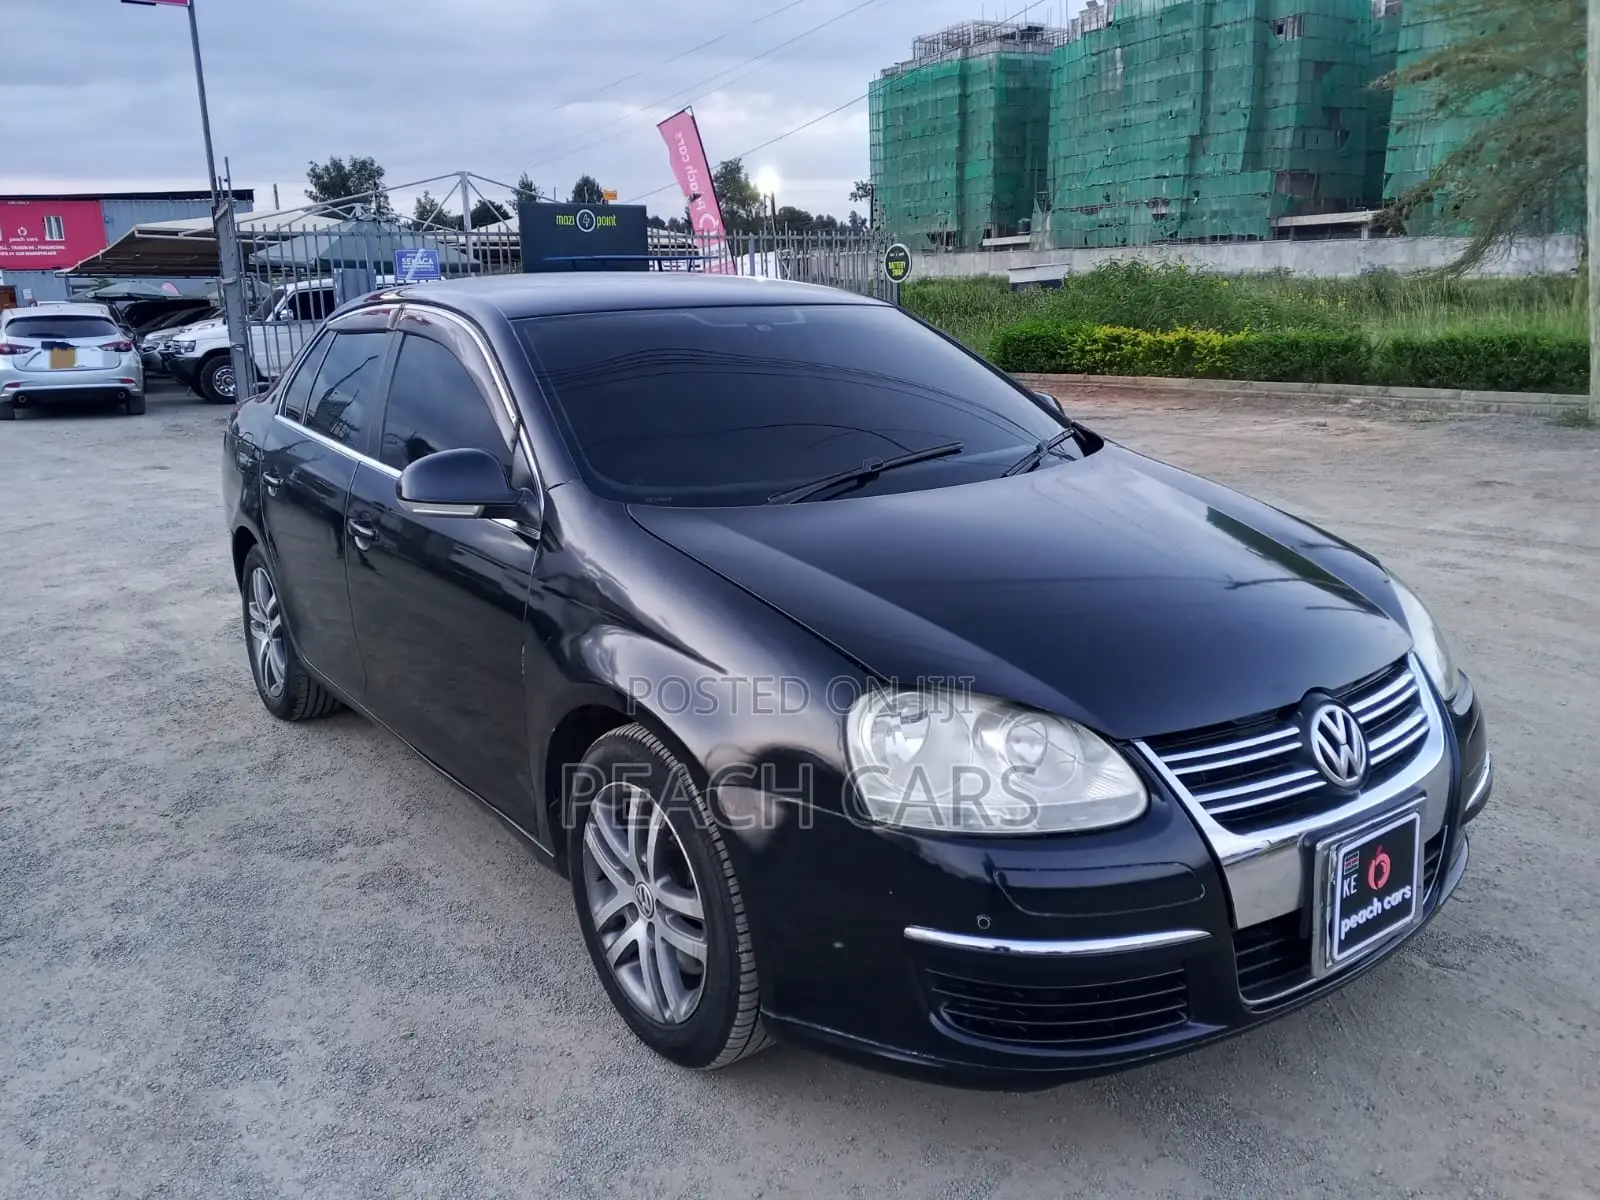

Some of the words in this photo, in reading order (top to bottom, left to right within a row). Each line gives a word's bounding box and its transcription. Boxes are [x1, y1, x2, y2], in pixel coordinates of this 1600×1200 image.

[596, 213, 617, 229] point
[1342, 873, 1358, 898] KE
[1340, 897, 1382, 940] peach
[1383, 885, 1413, 910] cars
